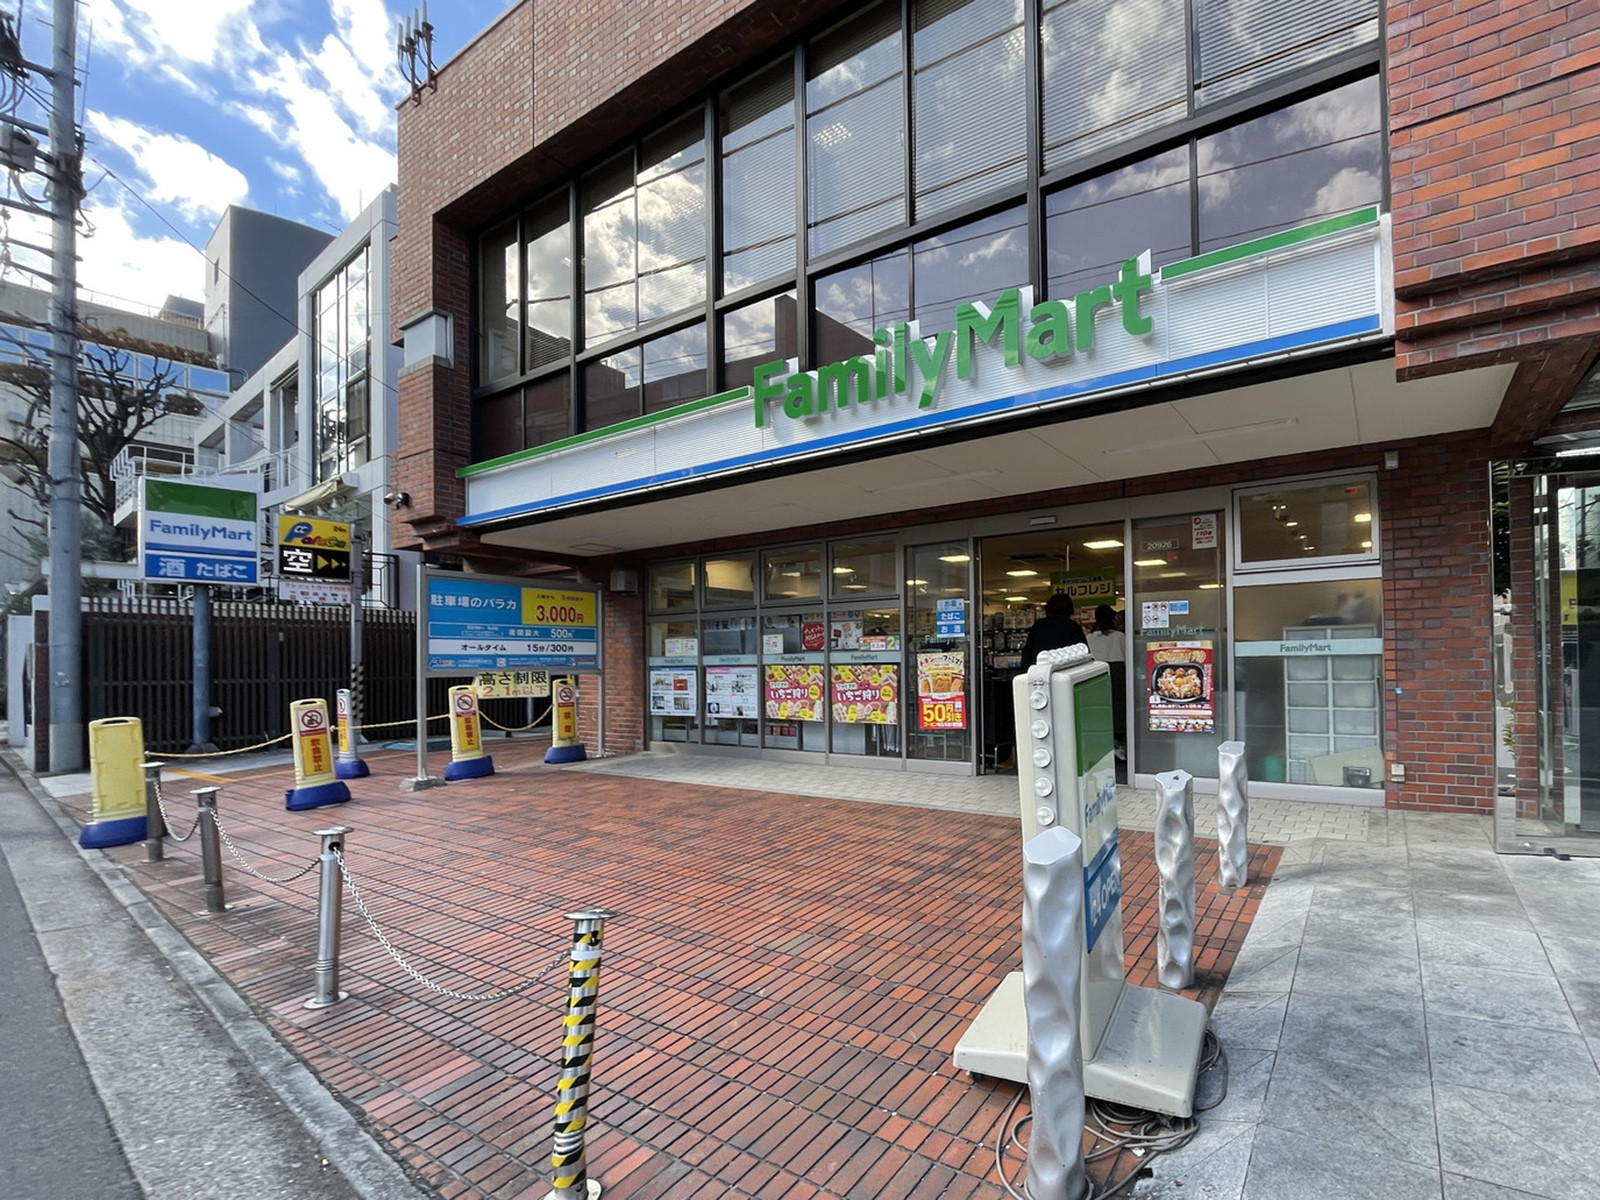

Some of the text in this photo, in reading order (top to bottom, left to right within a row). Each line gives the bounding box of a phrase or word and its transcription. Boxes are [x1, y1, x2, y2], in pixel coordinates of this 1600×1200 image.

[754, 253, 1153, 428] FamilyMart
[150, 519, 252, 541] FamilyMart
[283, 548, 313, 573] 空
[158, 557, 248, 579] 酒 たばこ
[1055, 583, 1111, 597] セルフレジ
[536, 604, 584, 624] 3,000円
[941, 612, 961, 620] たばこ
[1141, 624, 1204, 637] FamilyMart
[461, 643, 574, 653] オールタイム 15分/300円
[1280, 644, 1331, 653] FamilyMart
[479, 671, 548, 686] 高さ制限
[482, 685, 547, 697] 2.1m以下
[770, 688, 808, 699] いちご狩り
[837, 689, 880, 701] いちご狩り
